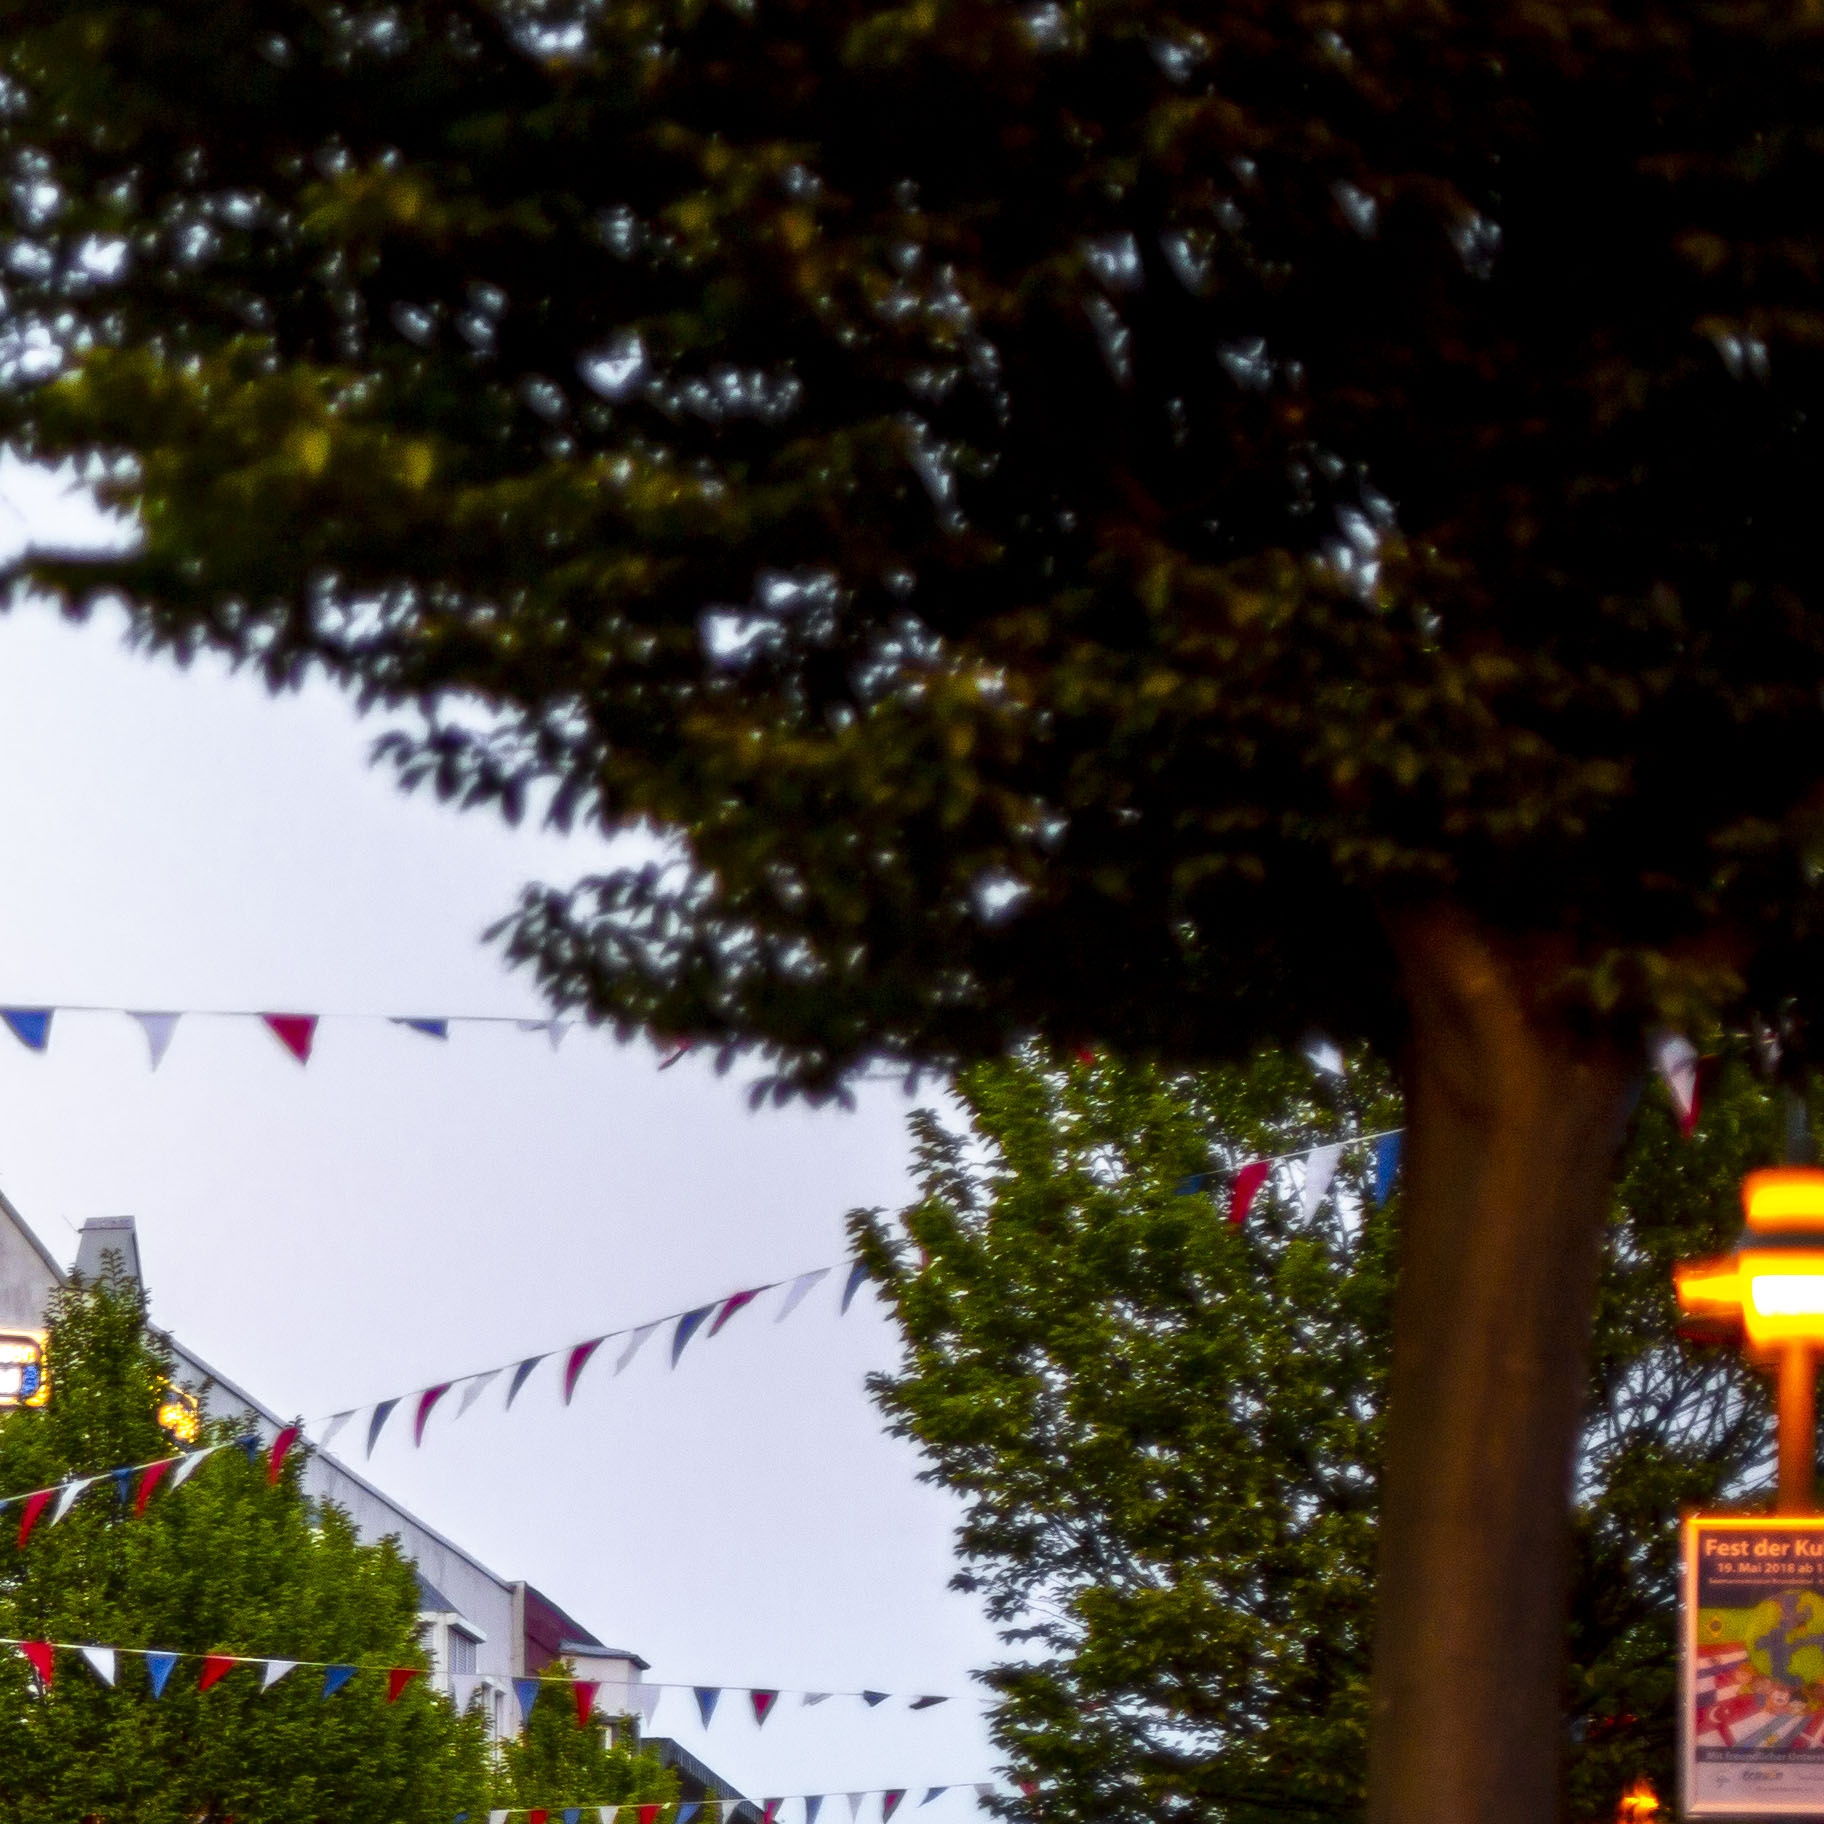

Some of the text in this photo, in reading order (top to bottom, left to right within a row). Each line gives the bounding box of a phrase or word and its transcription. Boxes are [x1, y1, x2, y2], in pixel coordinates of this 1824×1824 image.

[1705, 1539, 1749, 1556] Fest
[1753, 1538, 1790, 1556] der
[1739, 1563, 1763, 1573] Mai
